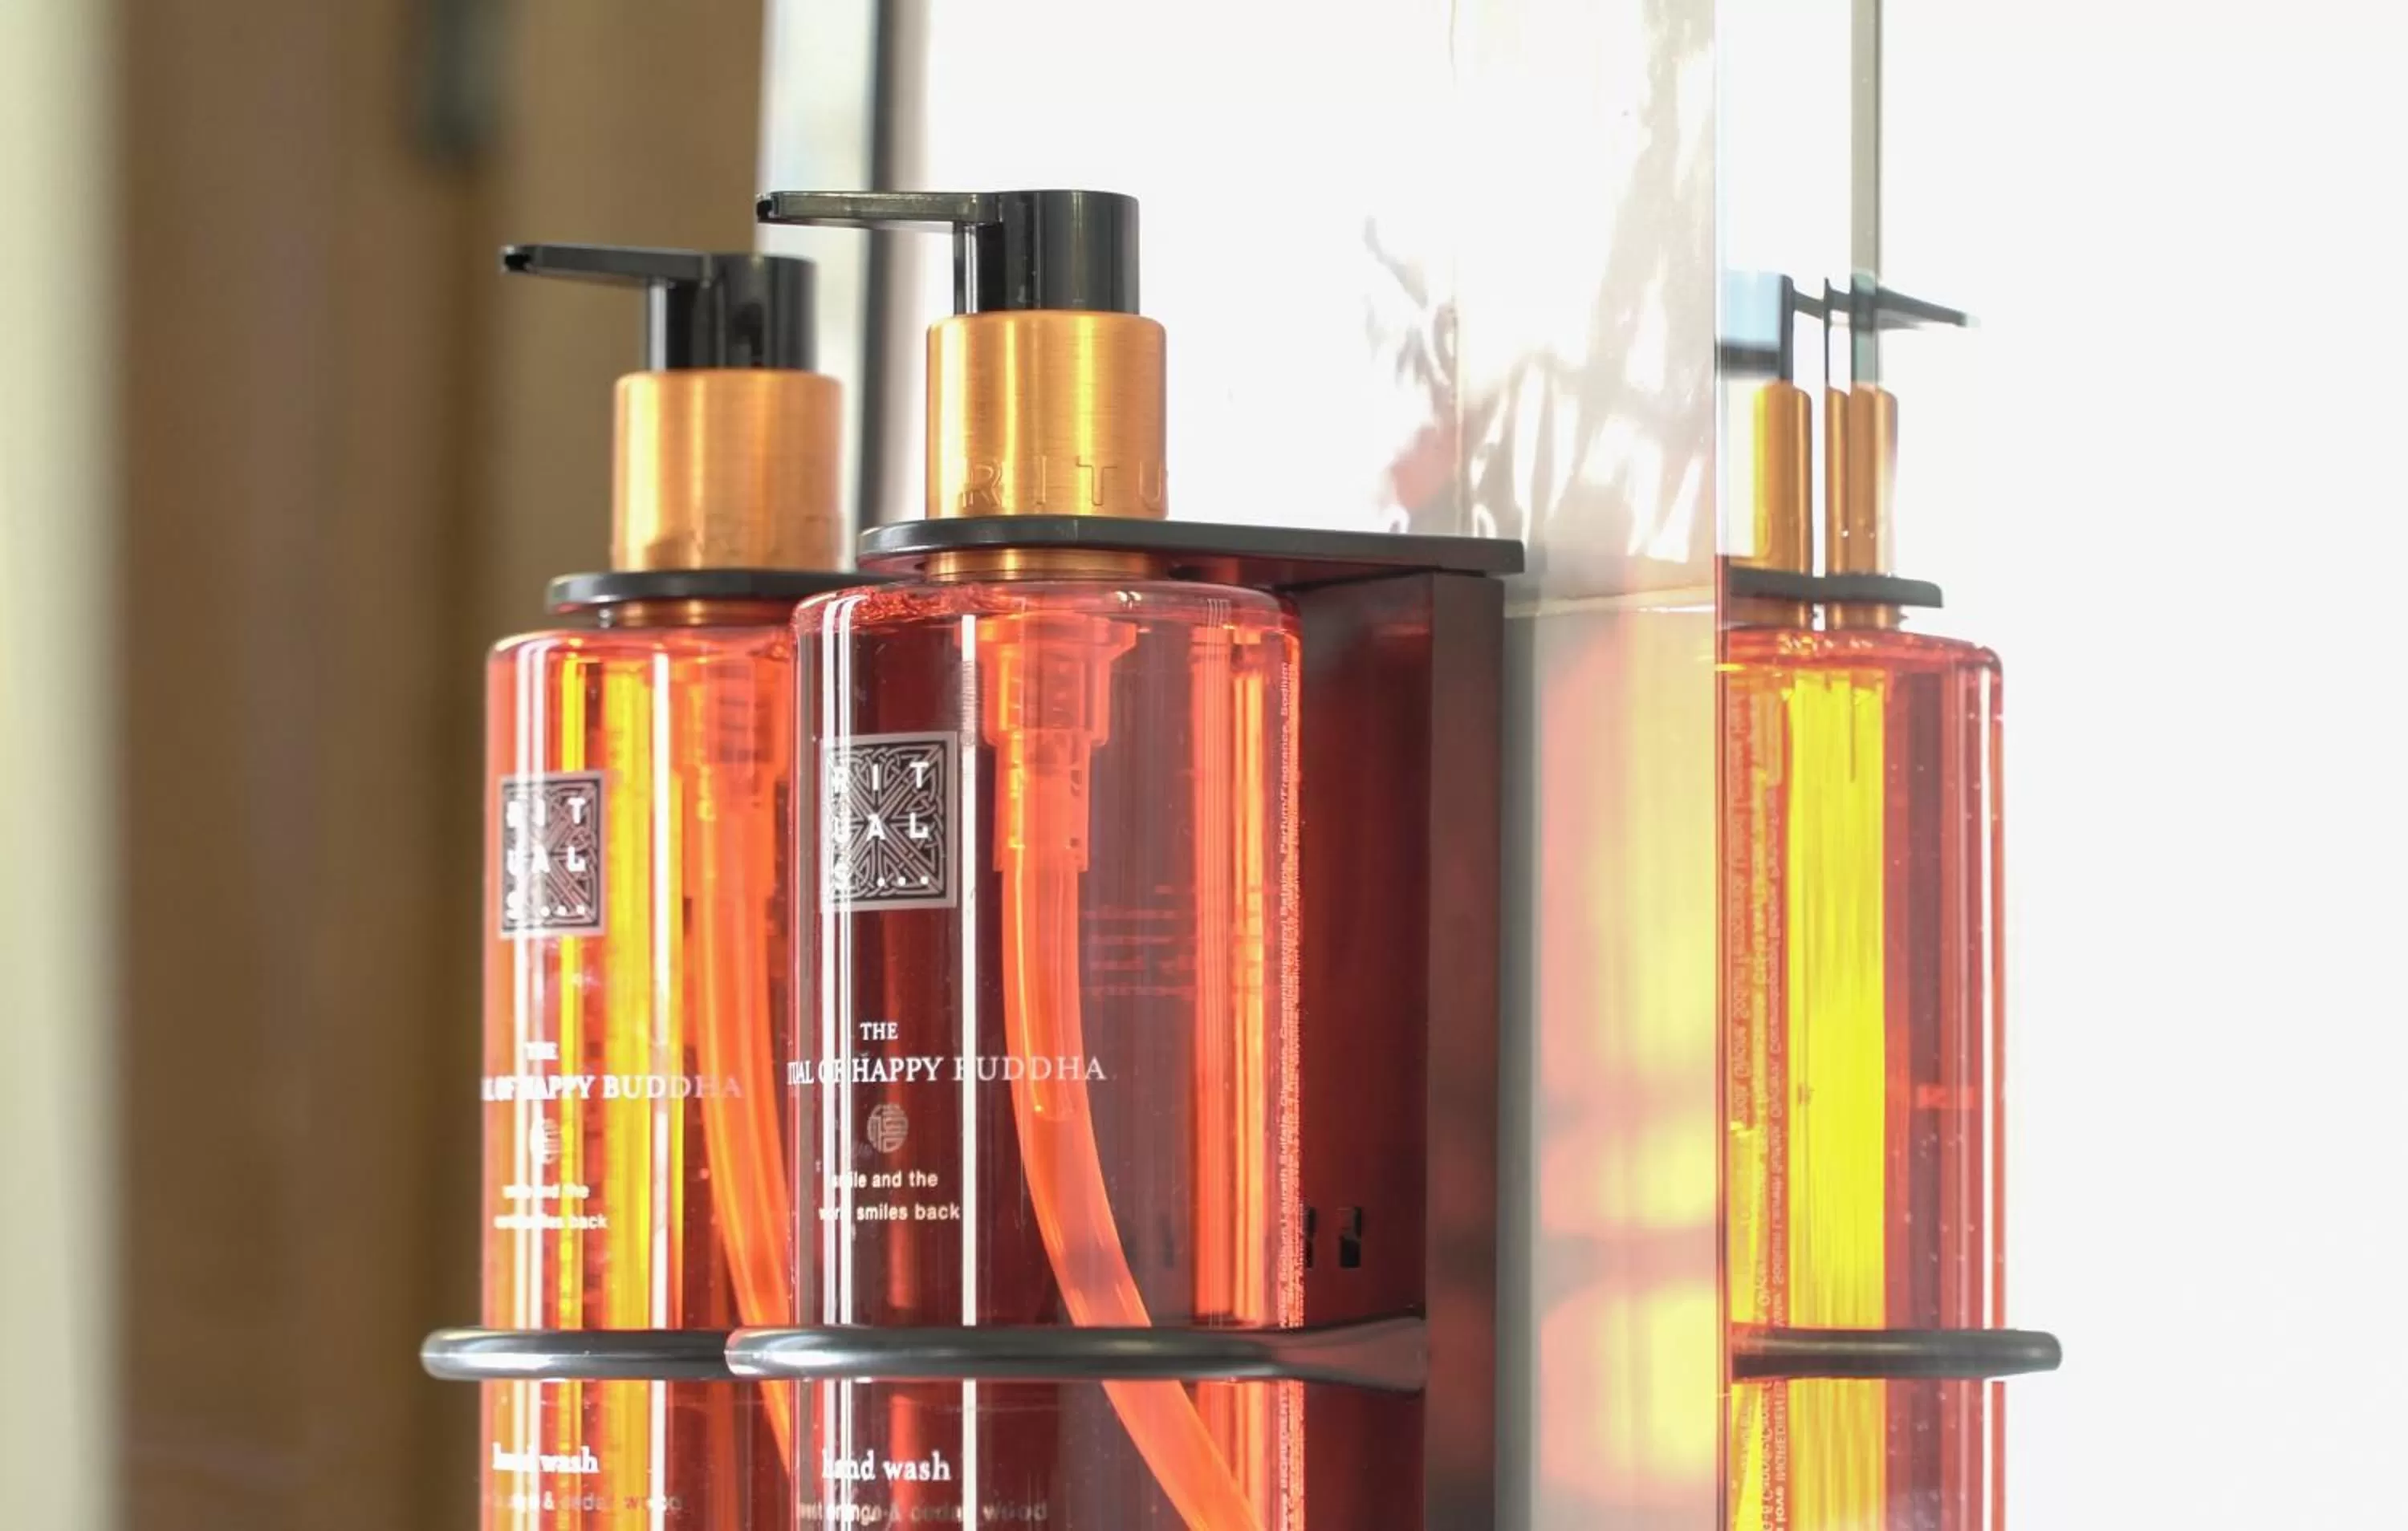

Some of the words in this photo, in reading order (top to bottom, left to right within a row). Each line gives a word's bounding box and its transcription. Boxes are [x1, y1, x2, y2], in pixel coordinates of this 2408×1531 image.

[860, 1021, 899, 1042] THE
[851, 1057, 944, 1082] HAPPY
[603, 1073, 746, 1099] BUDDHA
[832, 1169, 868, 1189] sle
[872, 1169, 903, 1189] and
[909, 1169, 938, 1188] the
[856, 1202, 909, 1221] smiles
[913, 1202, 961, 1221] back
[883, 1449, 951, 1480] wash
